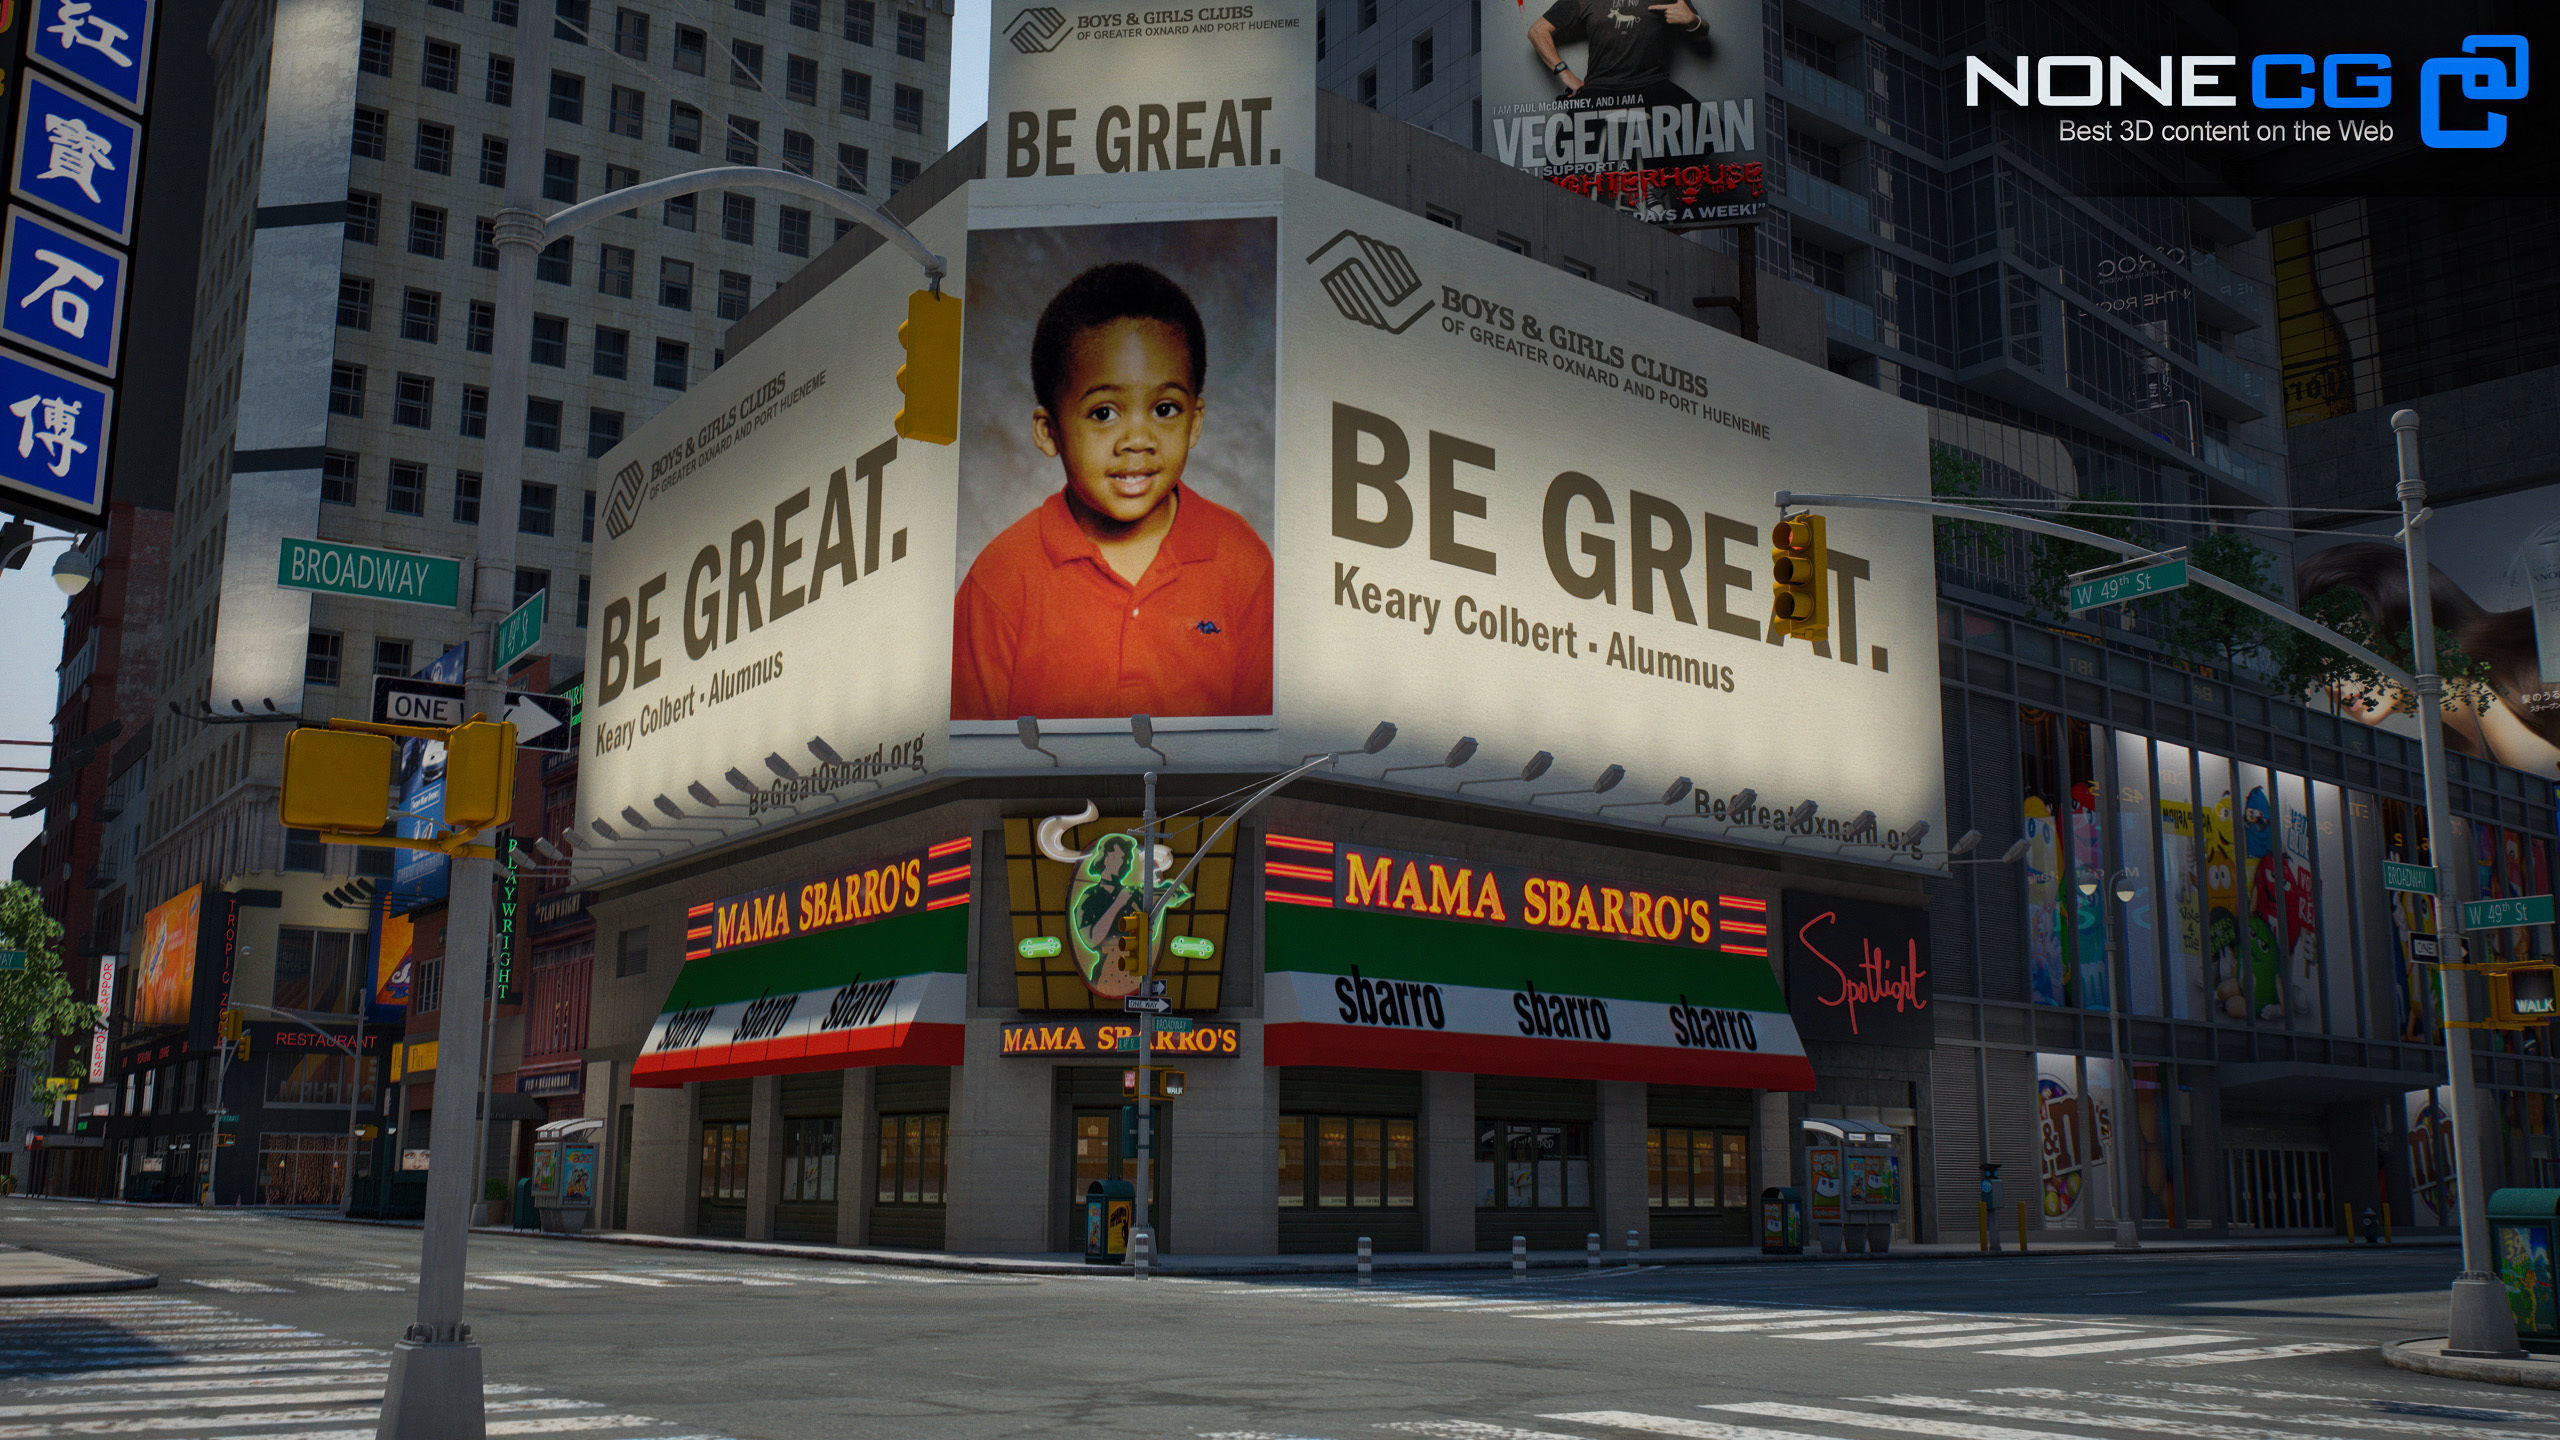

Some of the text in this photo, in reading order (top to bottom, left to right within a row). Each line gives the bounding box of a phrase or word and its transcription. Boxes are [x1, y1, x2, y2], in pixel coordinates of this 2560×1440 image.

[1077, 6, 1253, 28] BOYS & GIRLS CLUBS
[1077, 18, 1299, 41] OF GREATER OXNARD AND PORT HUENEME
[1493, 98, 1755, 168] VEGETARIAN
[1498, 104, 1512, 115] AM
[1514, 103, 1536, 113] PAUL
[1538, 98, 1594, 112] McCARTNEY,
[1596, 96, 1615, 107] AND
[1621, 95, 1636, 105] AM
[1637, 93, 1644, 104] A
[1006, 97, 1280, 178] BE GREAT.
[1543, 162, 1616, 176] SUPPORT
[1619, 161, 1630, 172] A
[1682, 208, 1694, 220] A
[1441, 285, 1709, 398] BOYS & GIRLS CLUBS
[1442, 316, 1770, 441] OF GREATER OXNARD AND PORT HUENEME
[649, 369, 827, 500] OF GREATER OXNARD AND PORT HUENEME
[650, 371, 787, 483] BOYS & GIRLS CLUBS
[1331, 401, 1889, 674] BE GRET.
[291, 546, 430, 597] BROADWAY
[598, 435, 908, 707] BE GREAT.
[2076, 573, 2152, 605] W 49th St
[1334, 561, 1735, 694] Keary Colbert Alumnus
[395, 696, 448, 721] ONE
[596, 718, 636, 757] Keary
[640, 684, 696, 737] Colbert
[708, 650, 783, 707] Alumnus
[715, 857, 921, 949] MAMA SBARRO'S
[1344, 852, 1713, 944] MAMA SBARRO'S
[2386, 866, 2427, 889] BROADWAY
[221, 899, 238, 984] TROPIC
[498, 838, 520, 1000] PLAYWRIGHT
[2470, 902, 2528, 925] W 49th St
[821, 972, 896, 1031] sbarro
[1335, 963, 1445, 1030] sbarro
[1799, 911, 1928, 1035] Spotlight
[656, 1001, 715, 1051] sbarro
[732, 986, 800, 1042] sbarro
[1513, 979, 1611, 1041] sbarro
[1669, 994, 1757, 1051] sbarro
[2515, 998, 2555, 1013] WALK
[275, 1032, 378, 1049] RESTAURANT
[1003, 1026, 1086, 1052] MAMA
[1097, 1025, 1238, 1053] SBRRO'S
